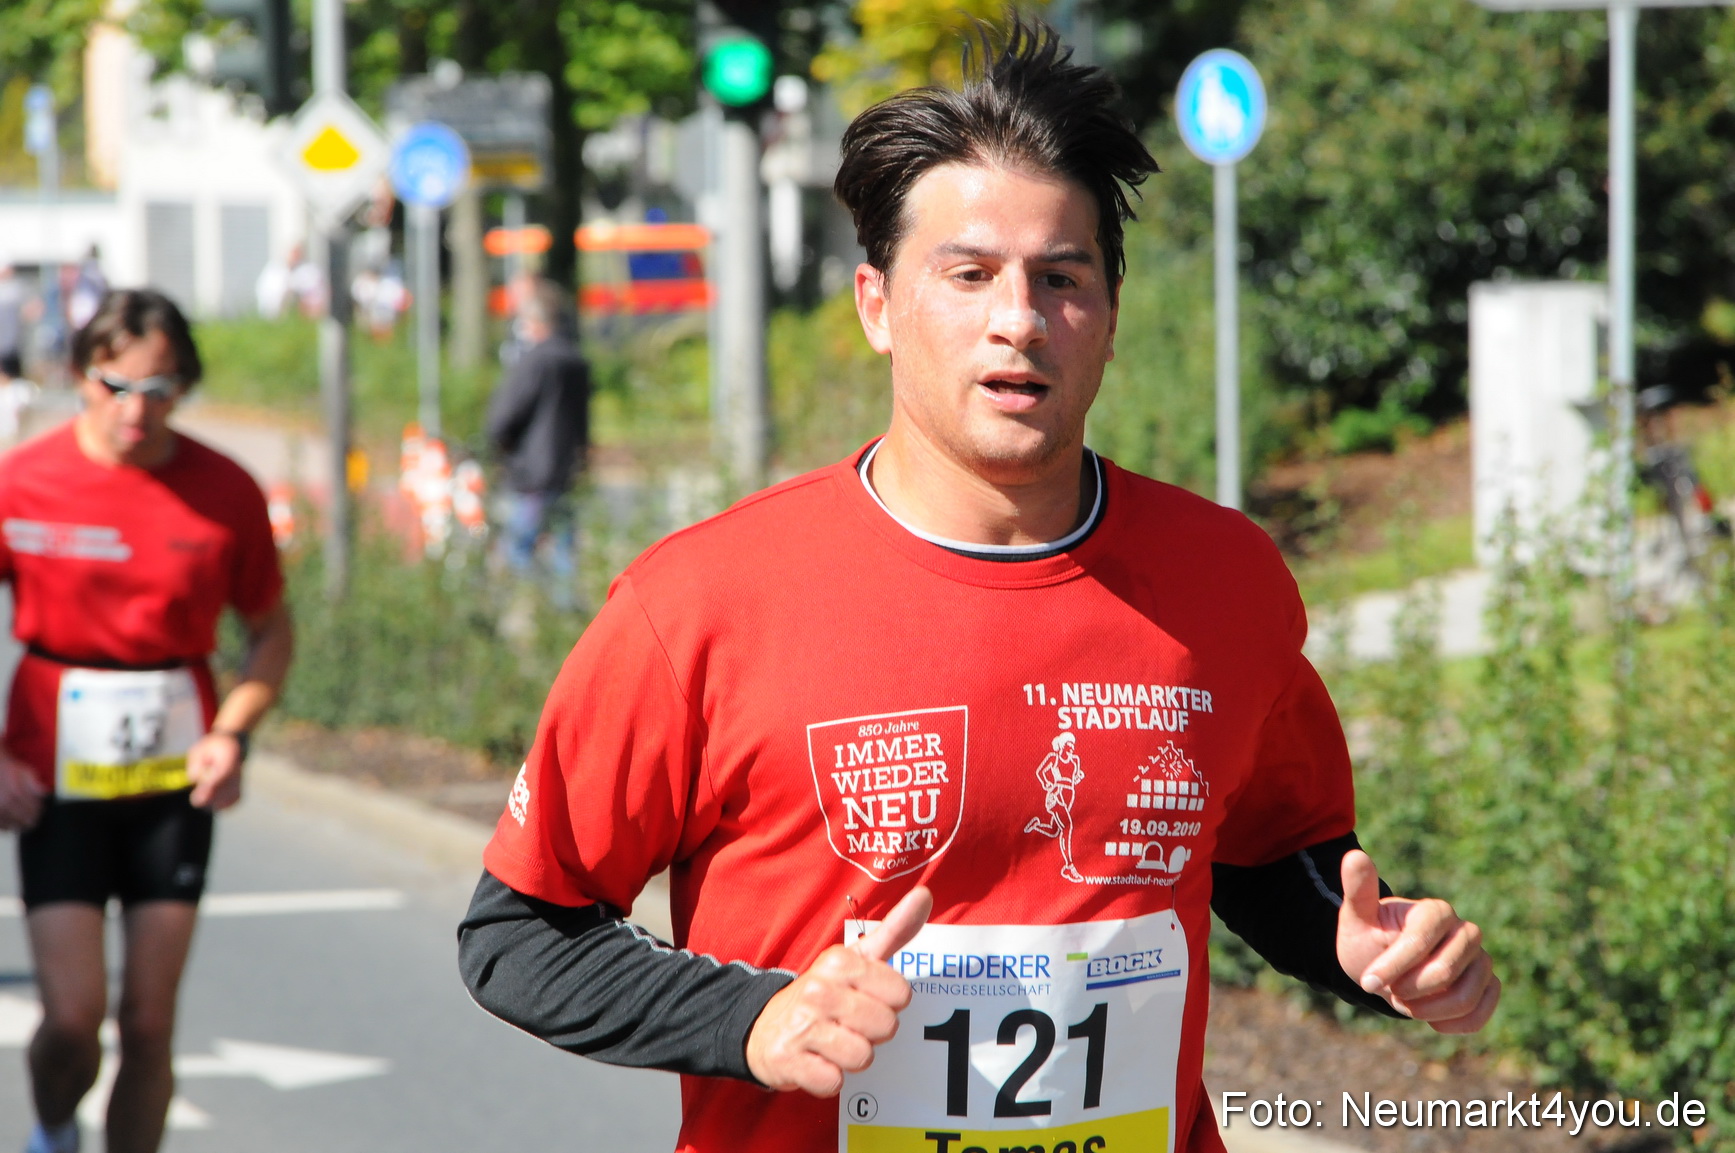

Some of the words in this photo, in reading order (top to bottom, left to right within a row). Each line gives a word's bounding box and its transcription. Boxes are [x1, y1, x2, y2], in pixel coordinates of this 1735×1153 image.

[1023, 683, 1057, 706] 11.
[1062, 683, 1213, 713] NEUMARKTER
[858, 723, 882, 738] 850
[884, 720, 919, 735] Jahre
[1058, 706, 1189, 733] STADTLAUF
[834, 733, 943, 768] IMMER
[831, 760, 949, 795] WIEDER
[842, 788, 941, 830] NEU
[846, 827, 938, 854] MARKT
[1119, 818, 1201, 836] 19.09.2010
[901, 951, 1051, 979] PFLEIDERER
[1087, 948, 1163, 978] BOCK
[910, 981, 1051, 996] KTIENGESELLSCHAFT
[923, 1002, 1108, 1118] 121
[856, 1097, 869, 1117] C
